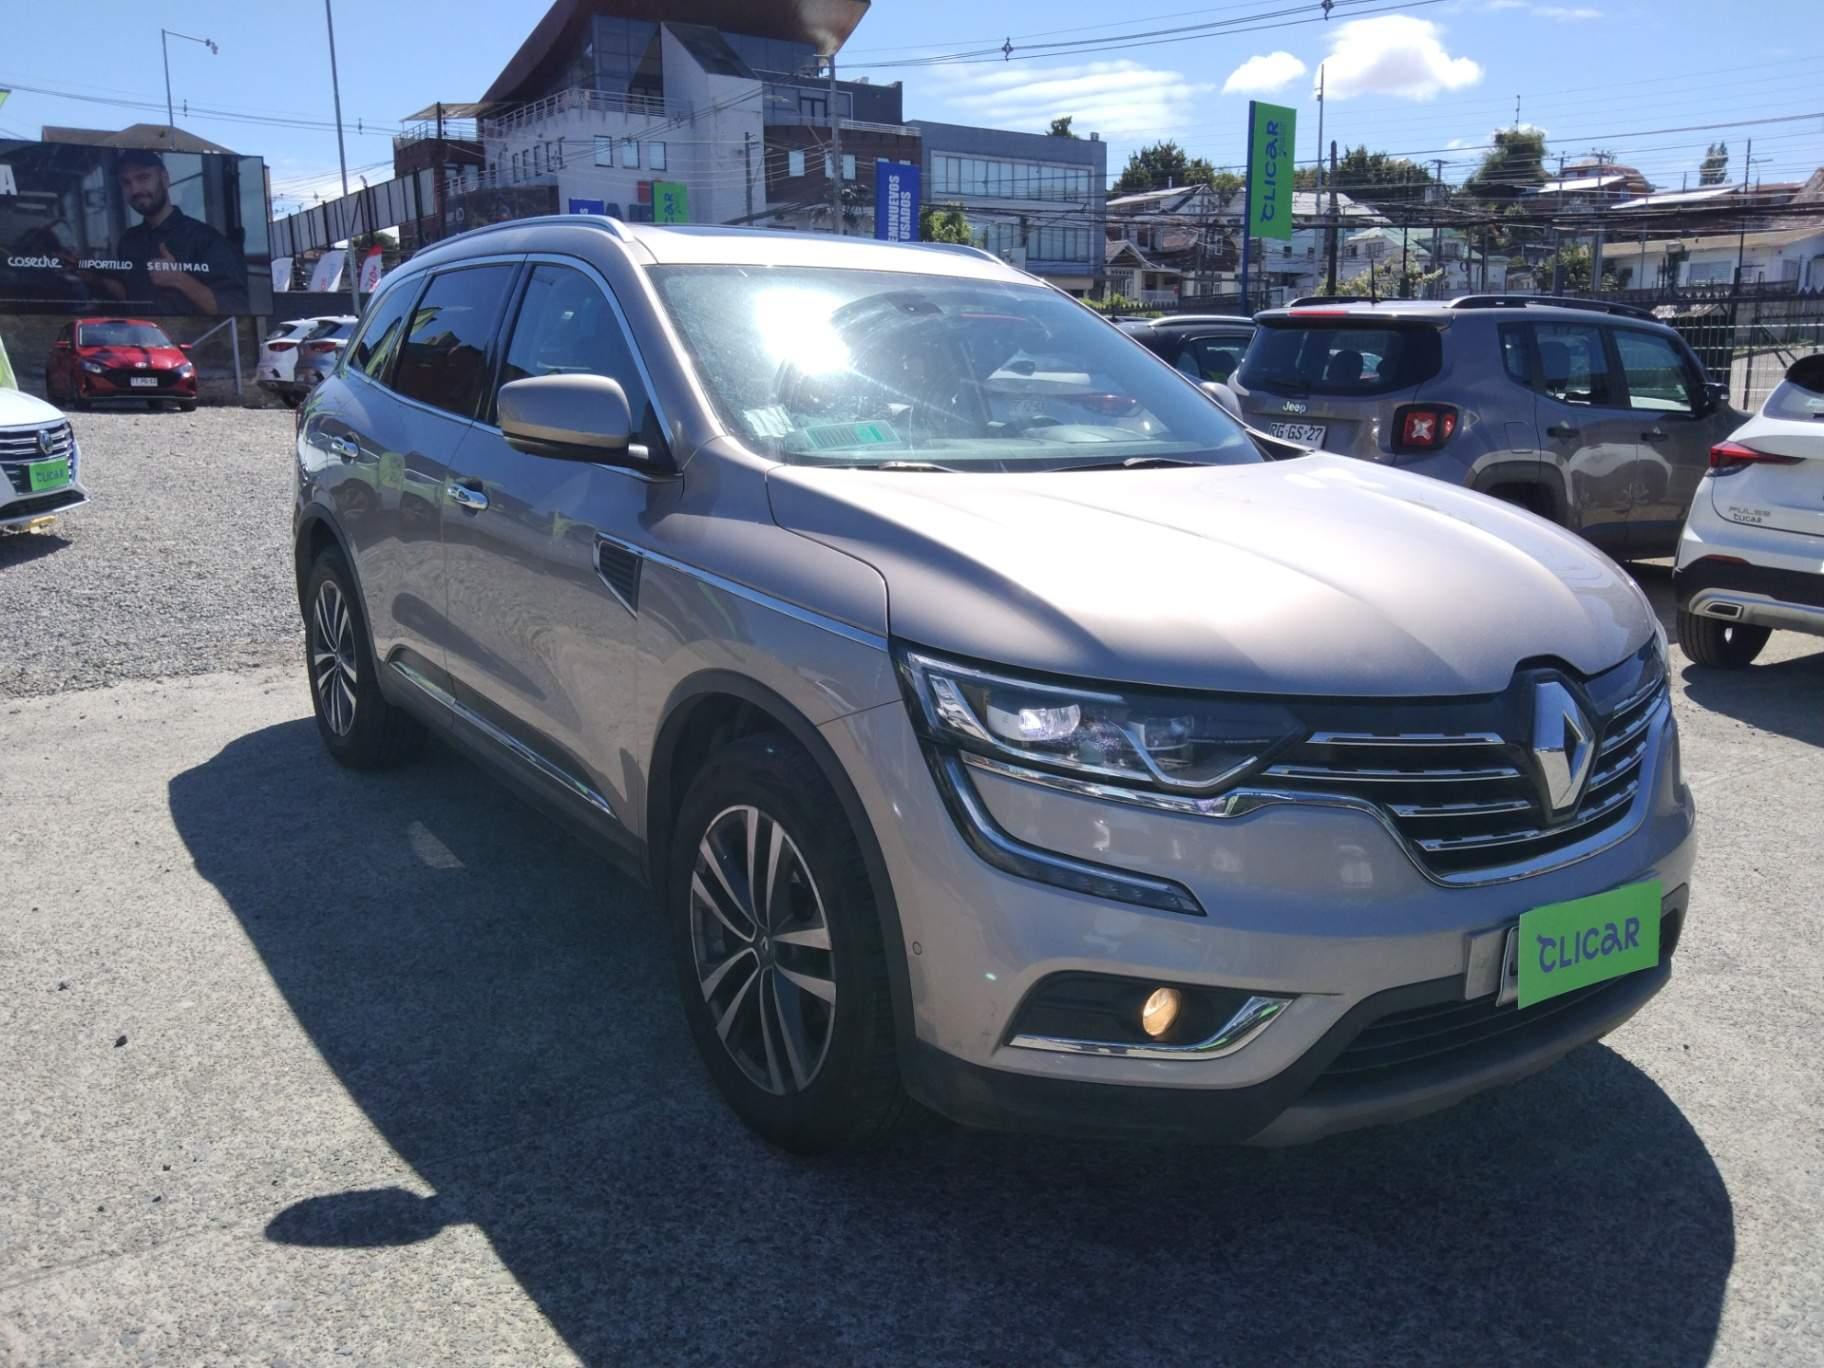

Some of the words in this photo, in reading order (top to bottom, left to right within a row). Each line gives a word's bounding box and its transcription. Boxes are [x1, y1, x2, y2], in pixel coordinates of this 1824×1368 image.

[888, 175, 900, 242] EMINUEVOS
[900, 191, 911, 239] USADOS
[147, 261, 210, 273] SERVIMAQ
[1282, 401, 1307, 414] Jeep
